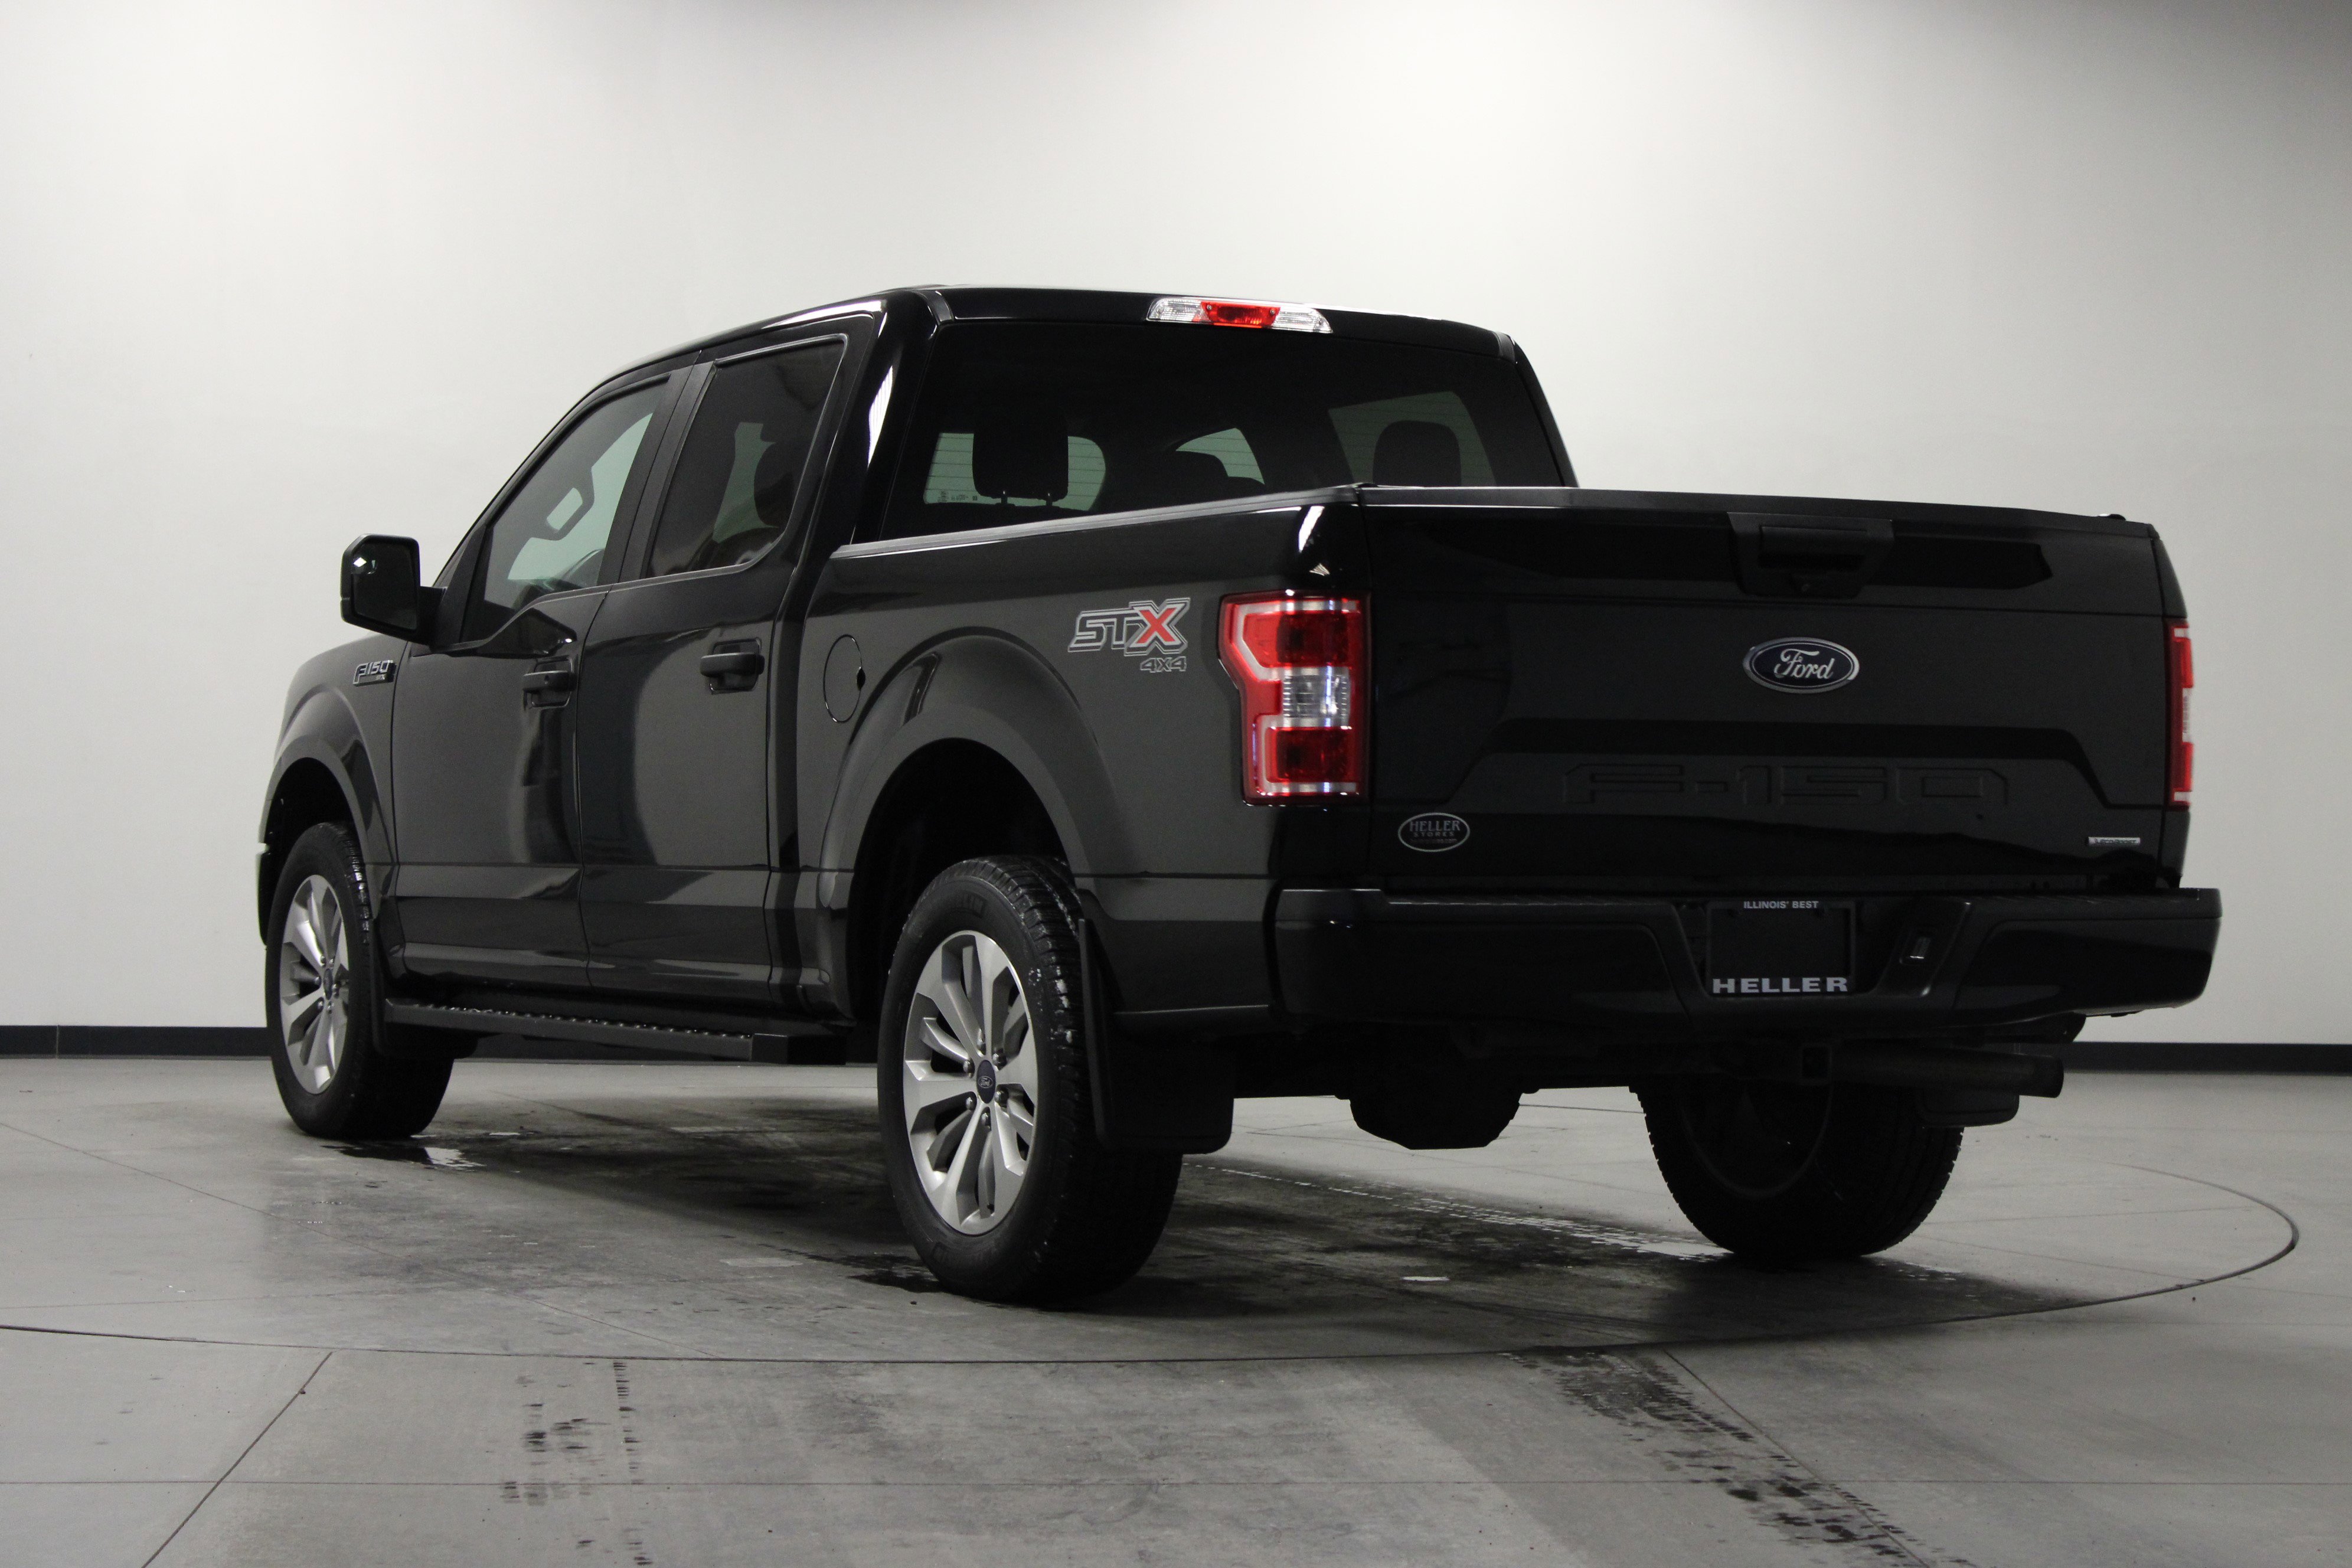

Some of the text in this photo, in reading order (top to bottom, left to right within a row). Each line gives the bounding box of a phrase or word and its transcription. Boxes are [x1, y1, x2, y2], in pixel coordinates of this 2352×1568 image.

[1067, 597, 1191, 656] STX
[1773, 648, 1836, 679] Ford
[1563, 763, 2007, 805] F-150
[1409, 820, 1461, 832] HELLER
[1743, 900, 1819, 909] ILLINOIS' BEST
[1713, 976, 1848, 994] HELLER
